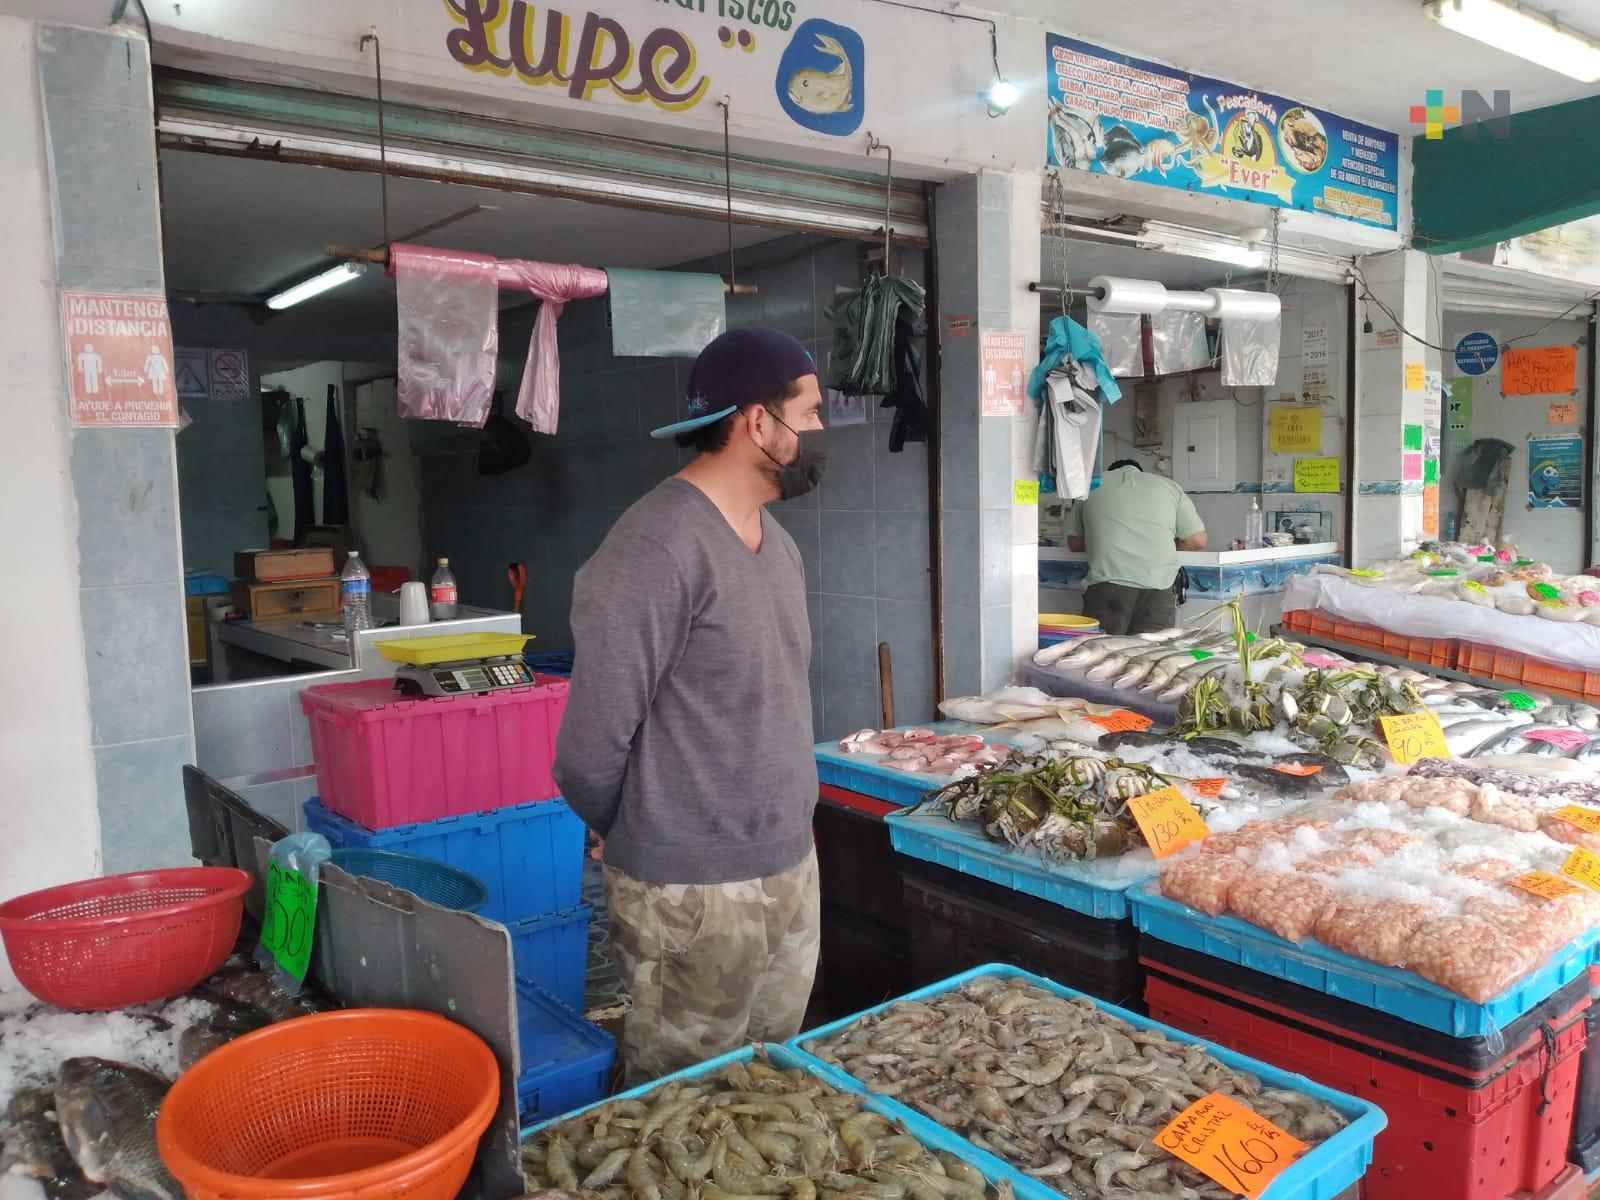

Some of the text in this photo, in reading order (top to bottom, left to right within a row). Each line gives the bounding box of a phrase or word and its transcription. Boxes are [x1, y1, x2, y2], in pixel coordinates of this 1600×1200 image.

[1074, 51, 1107, 71] VARIEDAD
[1108, 61, 1118, 74] DE
[1056, 62, 1111, 89] SELECCIONADOS
[1112, 79, 1121, 91] DE
[1355, 148, 1377, 162] MENUDEO
[1331, 168, 1337, 179] DE
[70, 298, 169, 319] MANTENGA
[74, 318, 168, 337] DISTANCIA
[1307, 329, 1324, 338] 2017
[983, 335, 1024, 348] MANTENGA
[985, 348, 1023, 361] DISTANCIA
[1507, 351, 1530, 374] HAY
[1517, 375, 1556, 395] SECO
[78, 400, 172, 411] AYUDE A PREVENIR
[96, 411, 160, 422] EL CONTAGIO
[1152, 820, 1180, 852] 130
[1212, 1138, 1279, 1192] 160
